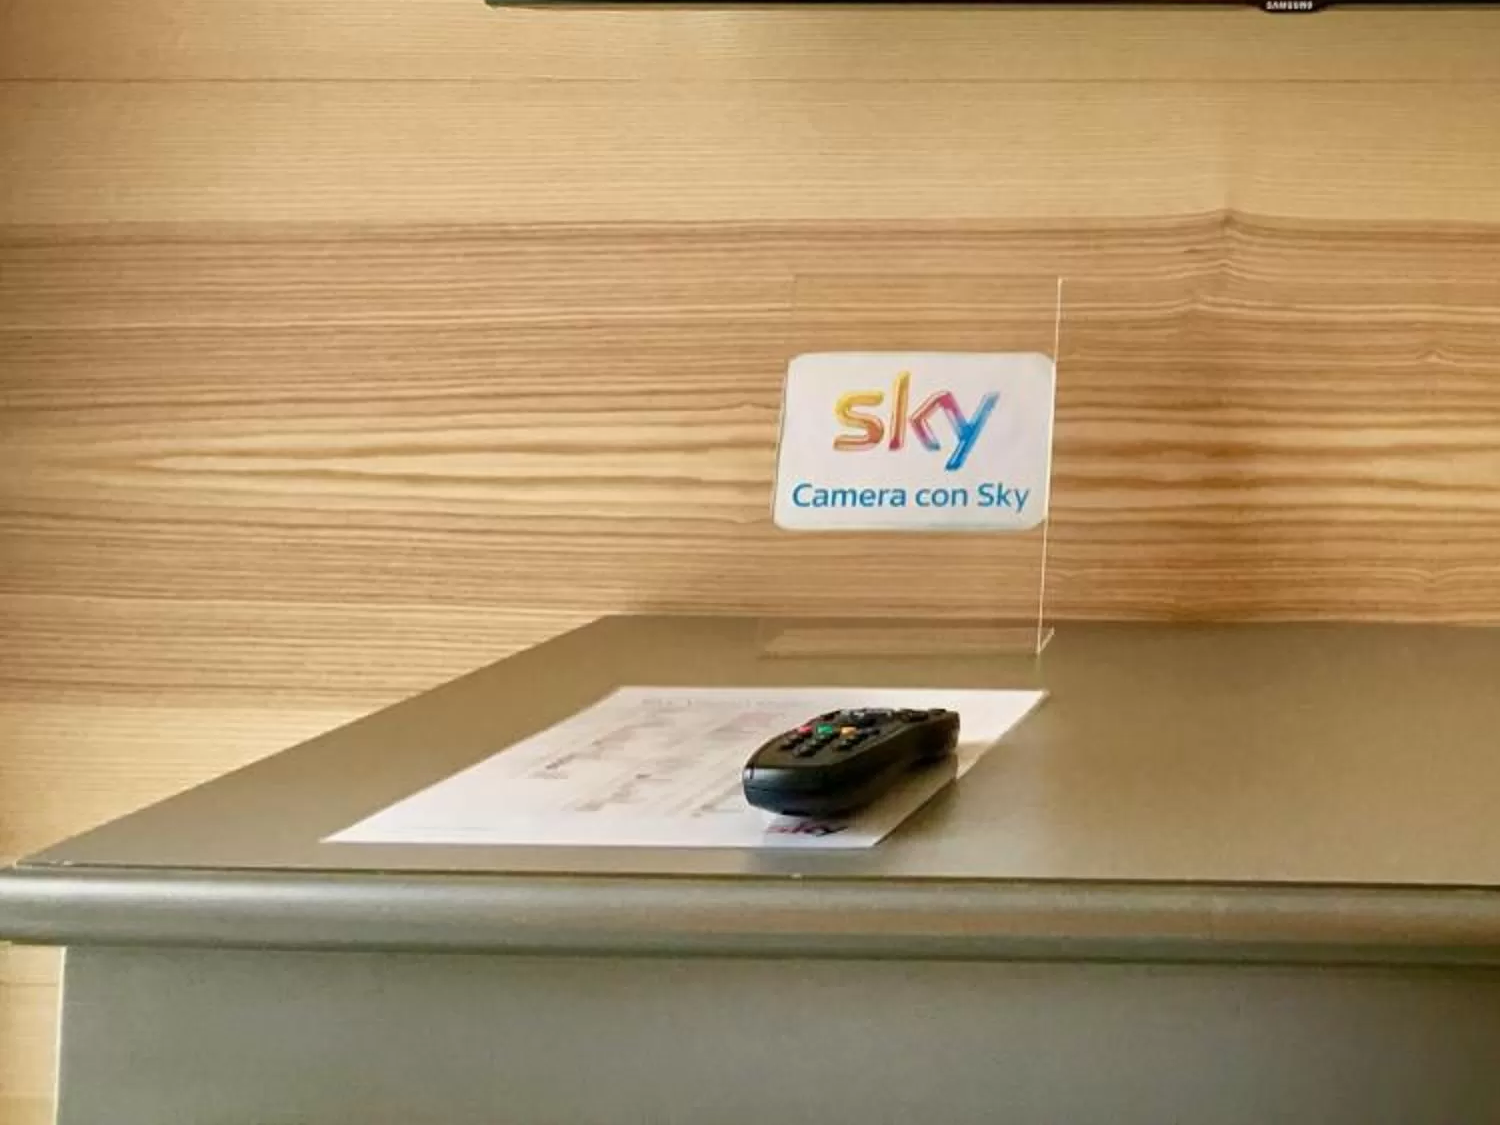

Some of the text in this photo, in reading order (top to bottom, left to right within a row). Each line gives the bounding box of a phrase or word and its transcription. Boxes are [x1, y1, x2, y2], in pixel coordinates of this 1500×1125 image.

[833, 371, 1001, 472] sky
[792, 480, 1030, 512] Camera con Sky
